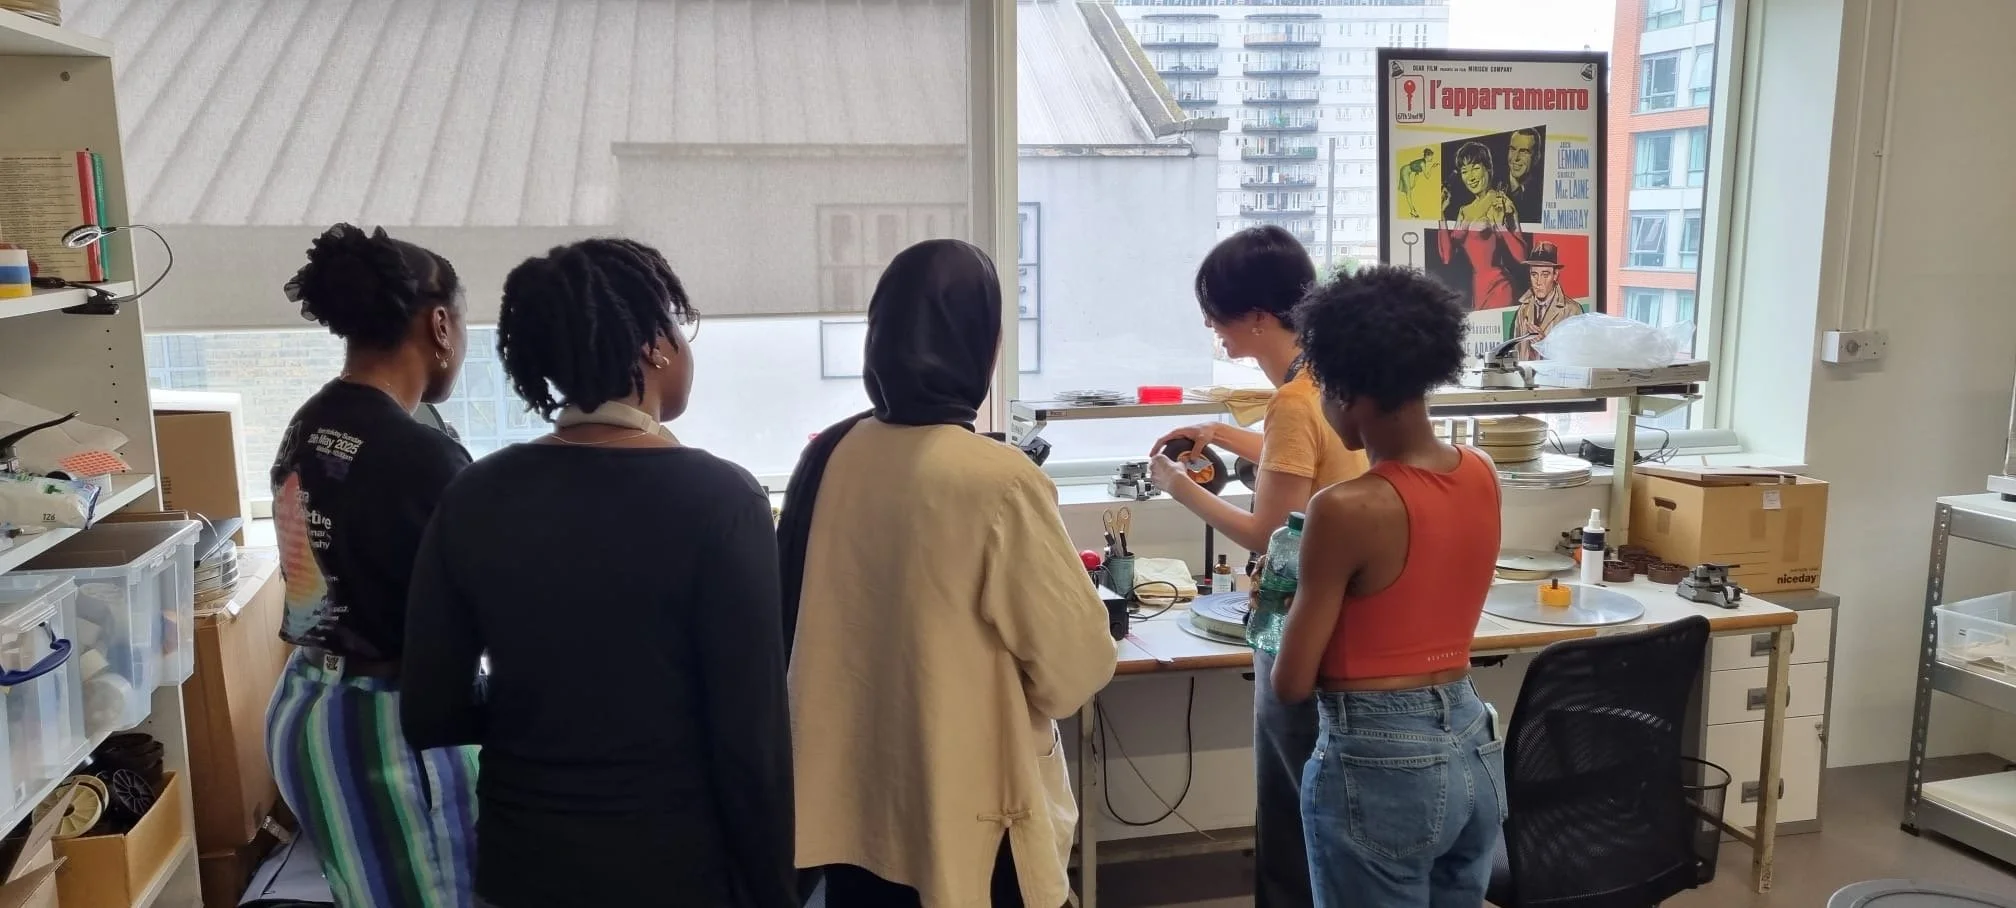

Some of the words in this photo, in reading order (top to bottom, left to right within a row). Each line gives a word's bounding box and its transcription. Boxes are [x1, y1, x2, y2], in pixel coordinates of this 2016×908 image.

[1426, 65, 1438, 73] FILM
[1557, 149, 1589, 169] LEMMON
[319, 434, 335, 448] May
[334, 439, 359, 454] 2025
[1777, 573, 1816, 584] niceday
